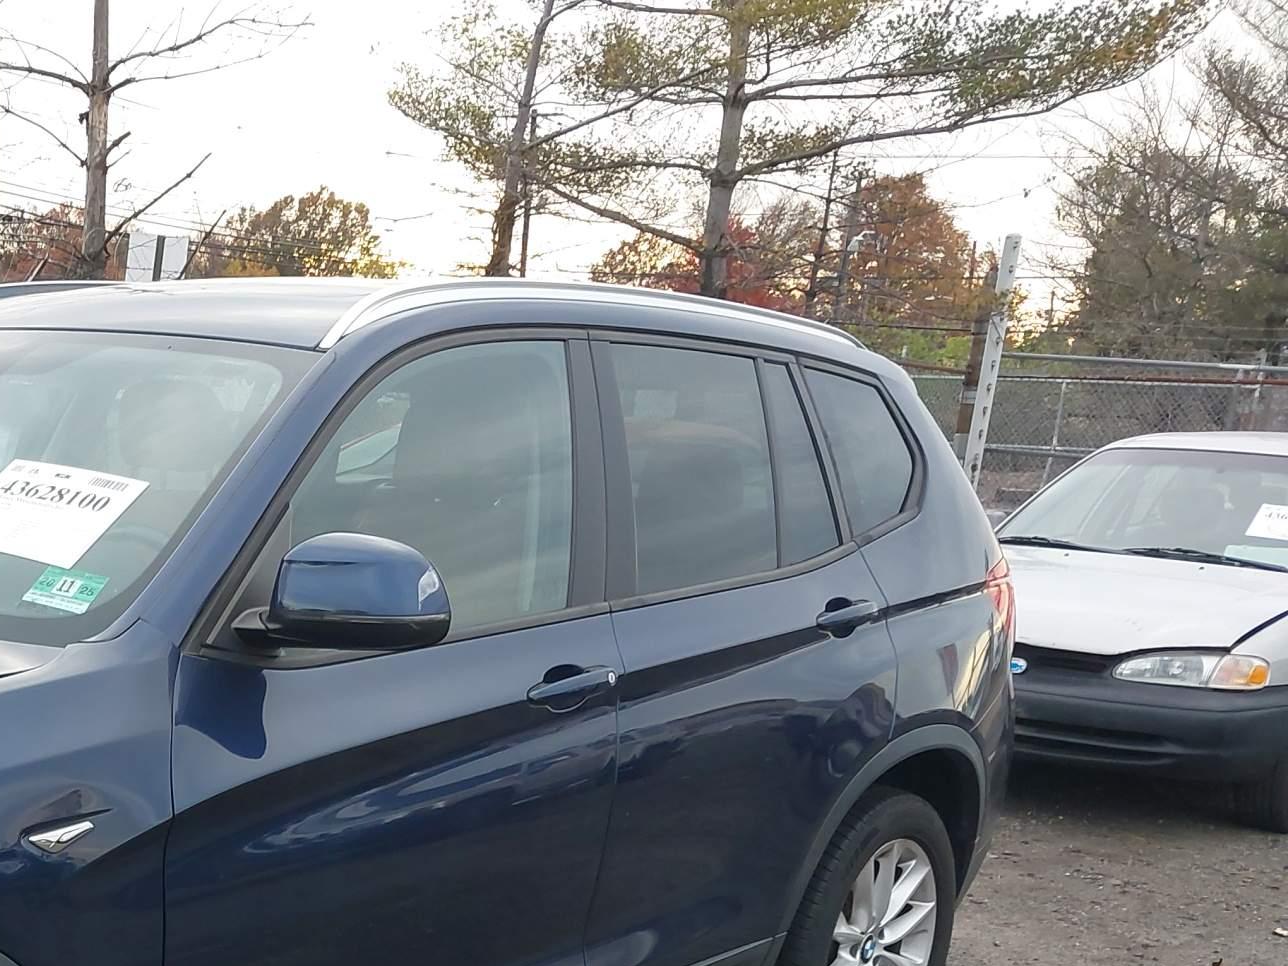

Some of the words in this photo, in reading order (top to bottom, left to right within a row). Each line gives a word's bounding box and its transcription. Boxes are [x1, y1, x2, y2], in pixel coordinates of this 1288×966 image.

[0, 479, 111, 512] 43628100
[38, 576, 56, 587] 20
[56, 579, 77, 593] 11
[79, 585, 95, 597] 25
